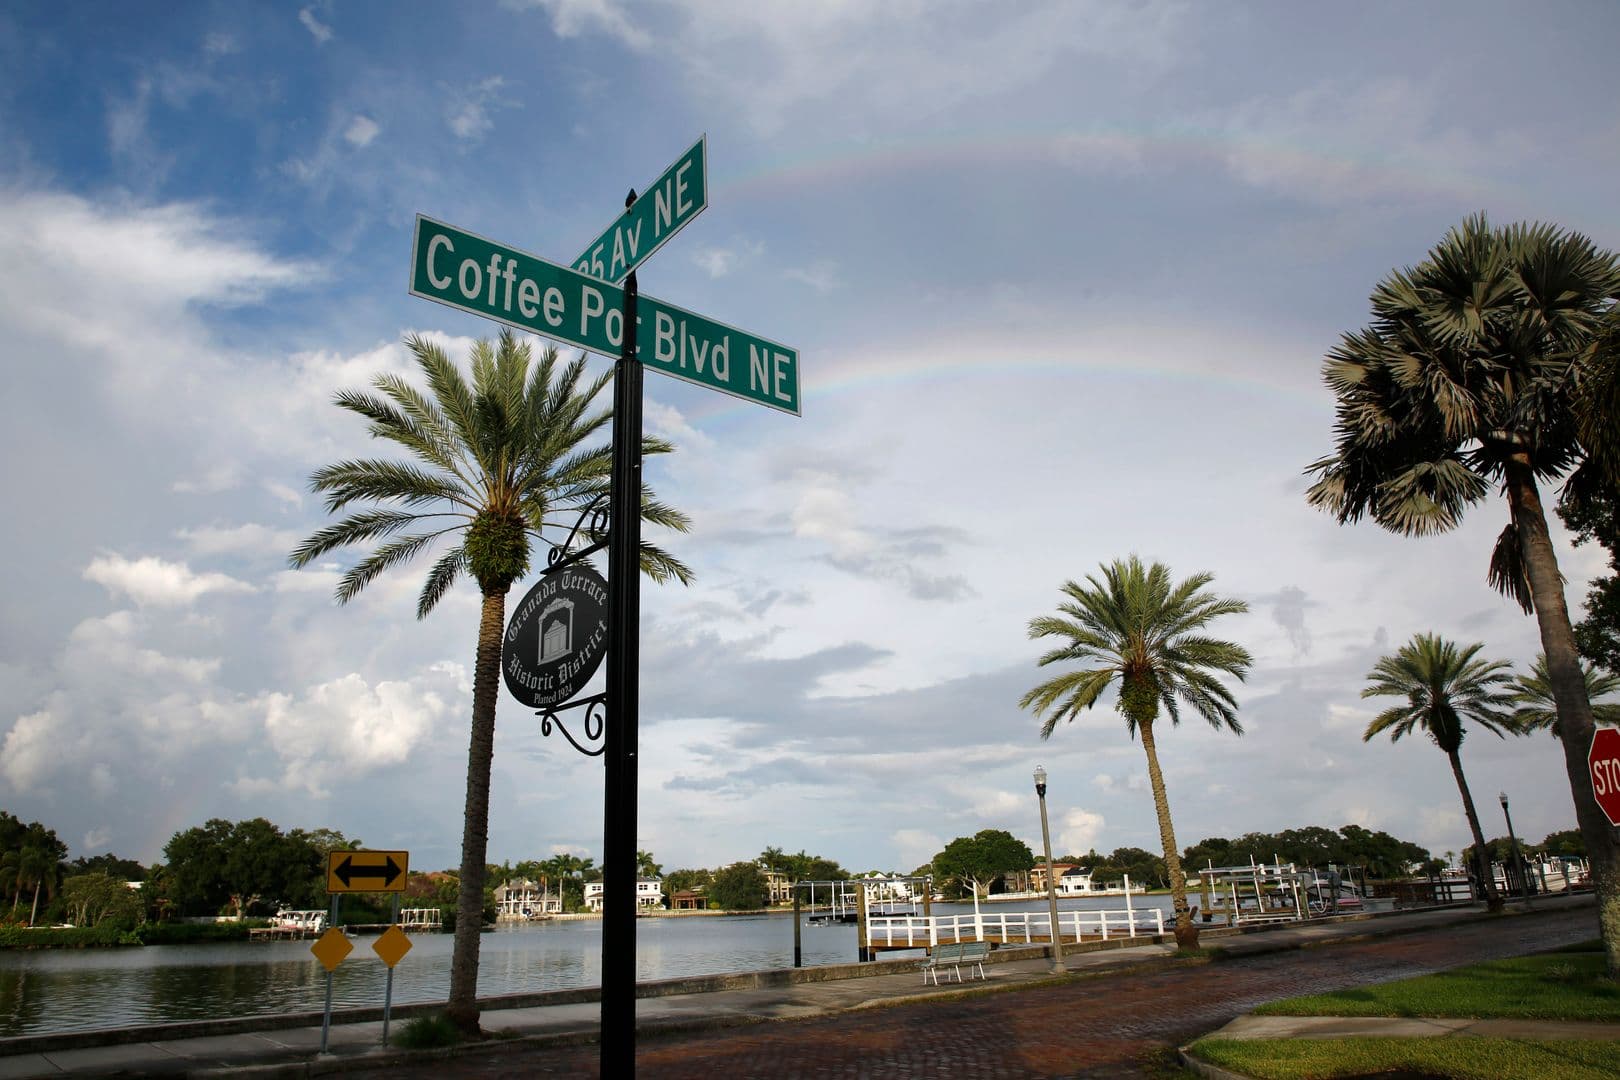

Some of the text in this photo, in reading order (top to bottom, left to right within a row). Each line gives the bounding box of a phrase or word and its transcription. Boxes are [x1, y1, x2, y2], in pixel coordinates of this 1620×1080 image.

[610, 218, 642, 279] Av
[655, 159, 692, 237] NE
[426, 234, 565, 327] Coffee
[655, 311, 729, 383] Blvd
[750, 344, 791, 402] NE
[508, 571, 607, 642] Granada Terrace
[508, 619, 607, 691] Historic District
[1594, 758, 1620, 795] STO
